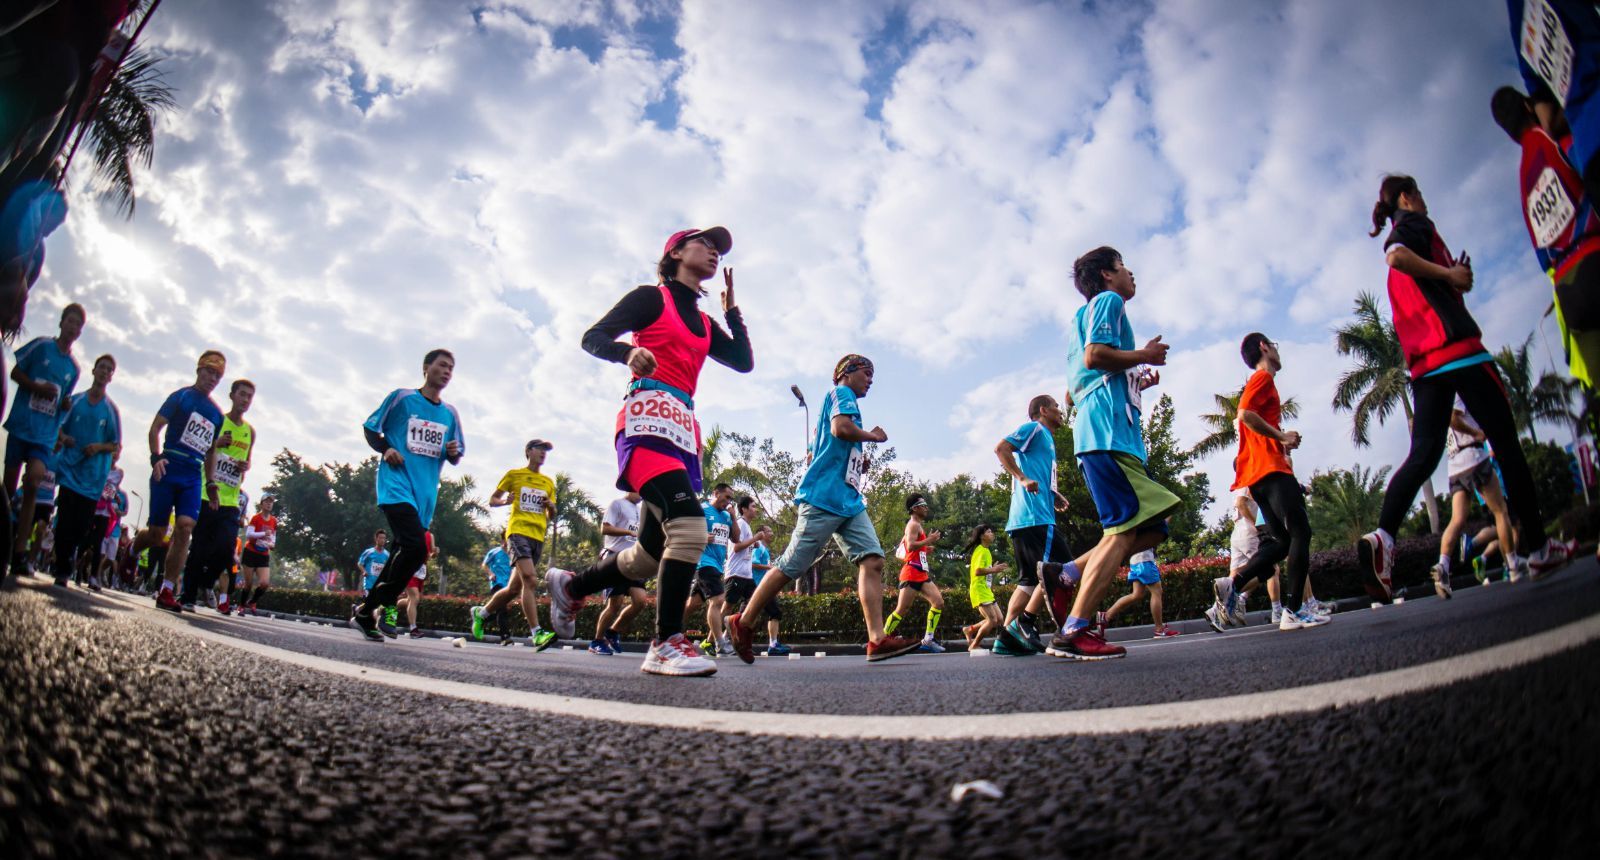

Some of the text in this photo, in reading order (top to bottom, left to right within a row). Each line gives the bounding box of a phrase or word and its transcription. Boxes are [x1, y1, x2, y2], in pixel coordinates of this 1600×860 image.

[1532, 176, 1562, 227] 19337
[630, 399, 693, 433] 02688
[410, 427, 443, 445] 11889
[521, 492, 543, 505] 0102
